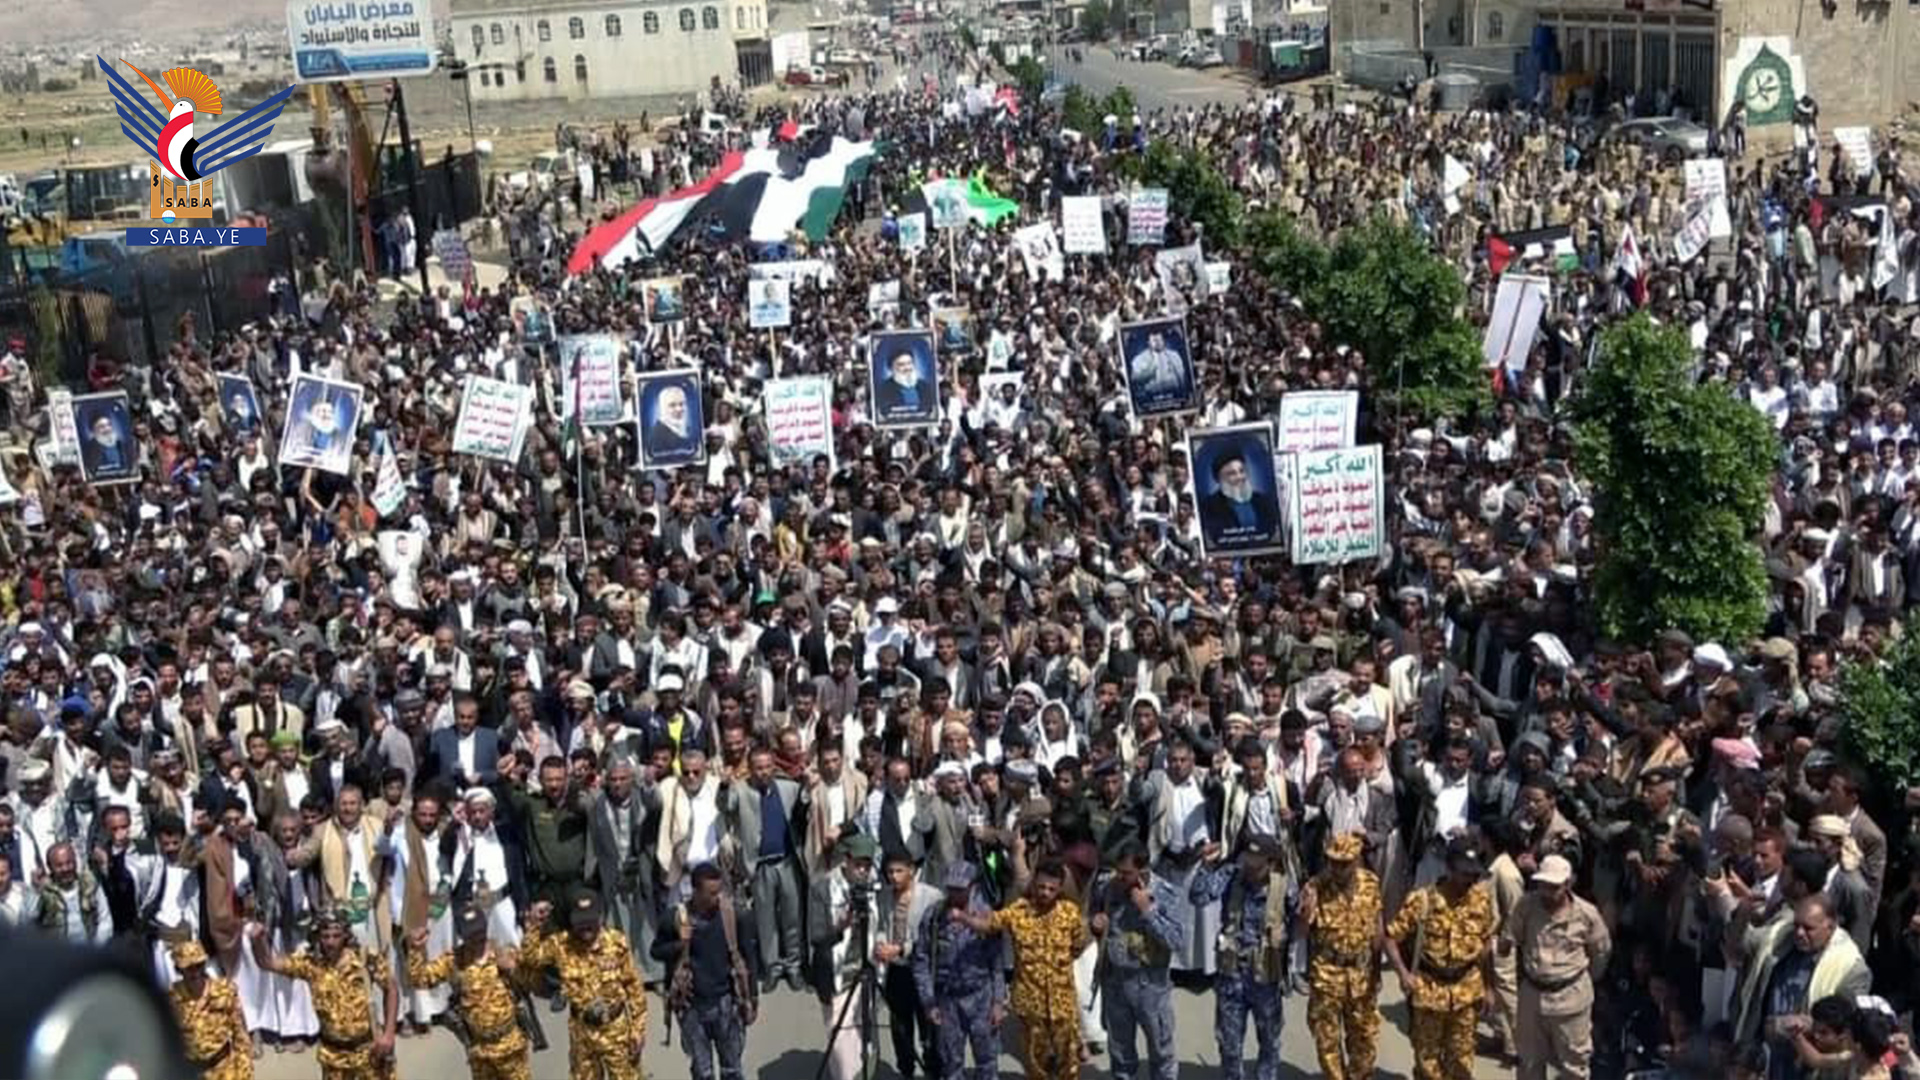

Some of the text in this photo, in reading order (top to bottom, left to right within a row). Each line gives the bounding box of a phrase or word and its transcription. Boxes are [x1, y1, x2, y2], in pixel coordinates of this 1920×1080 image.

[305, 1, 413, 25] معرض اليابان
[301, 22, 421, 46] للتجارة والاستيراد
[1302, 453, 1342, 480] أكبر
[1346, 455, 1373, 472] الله
